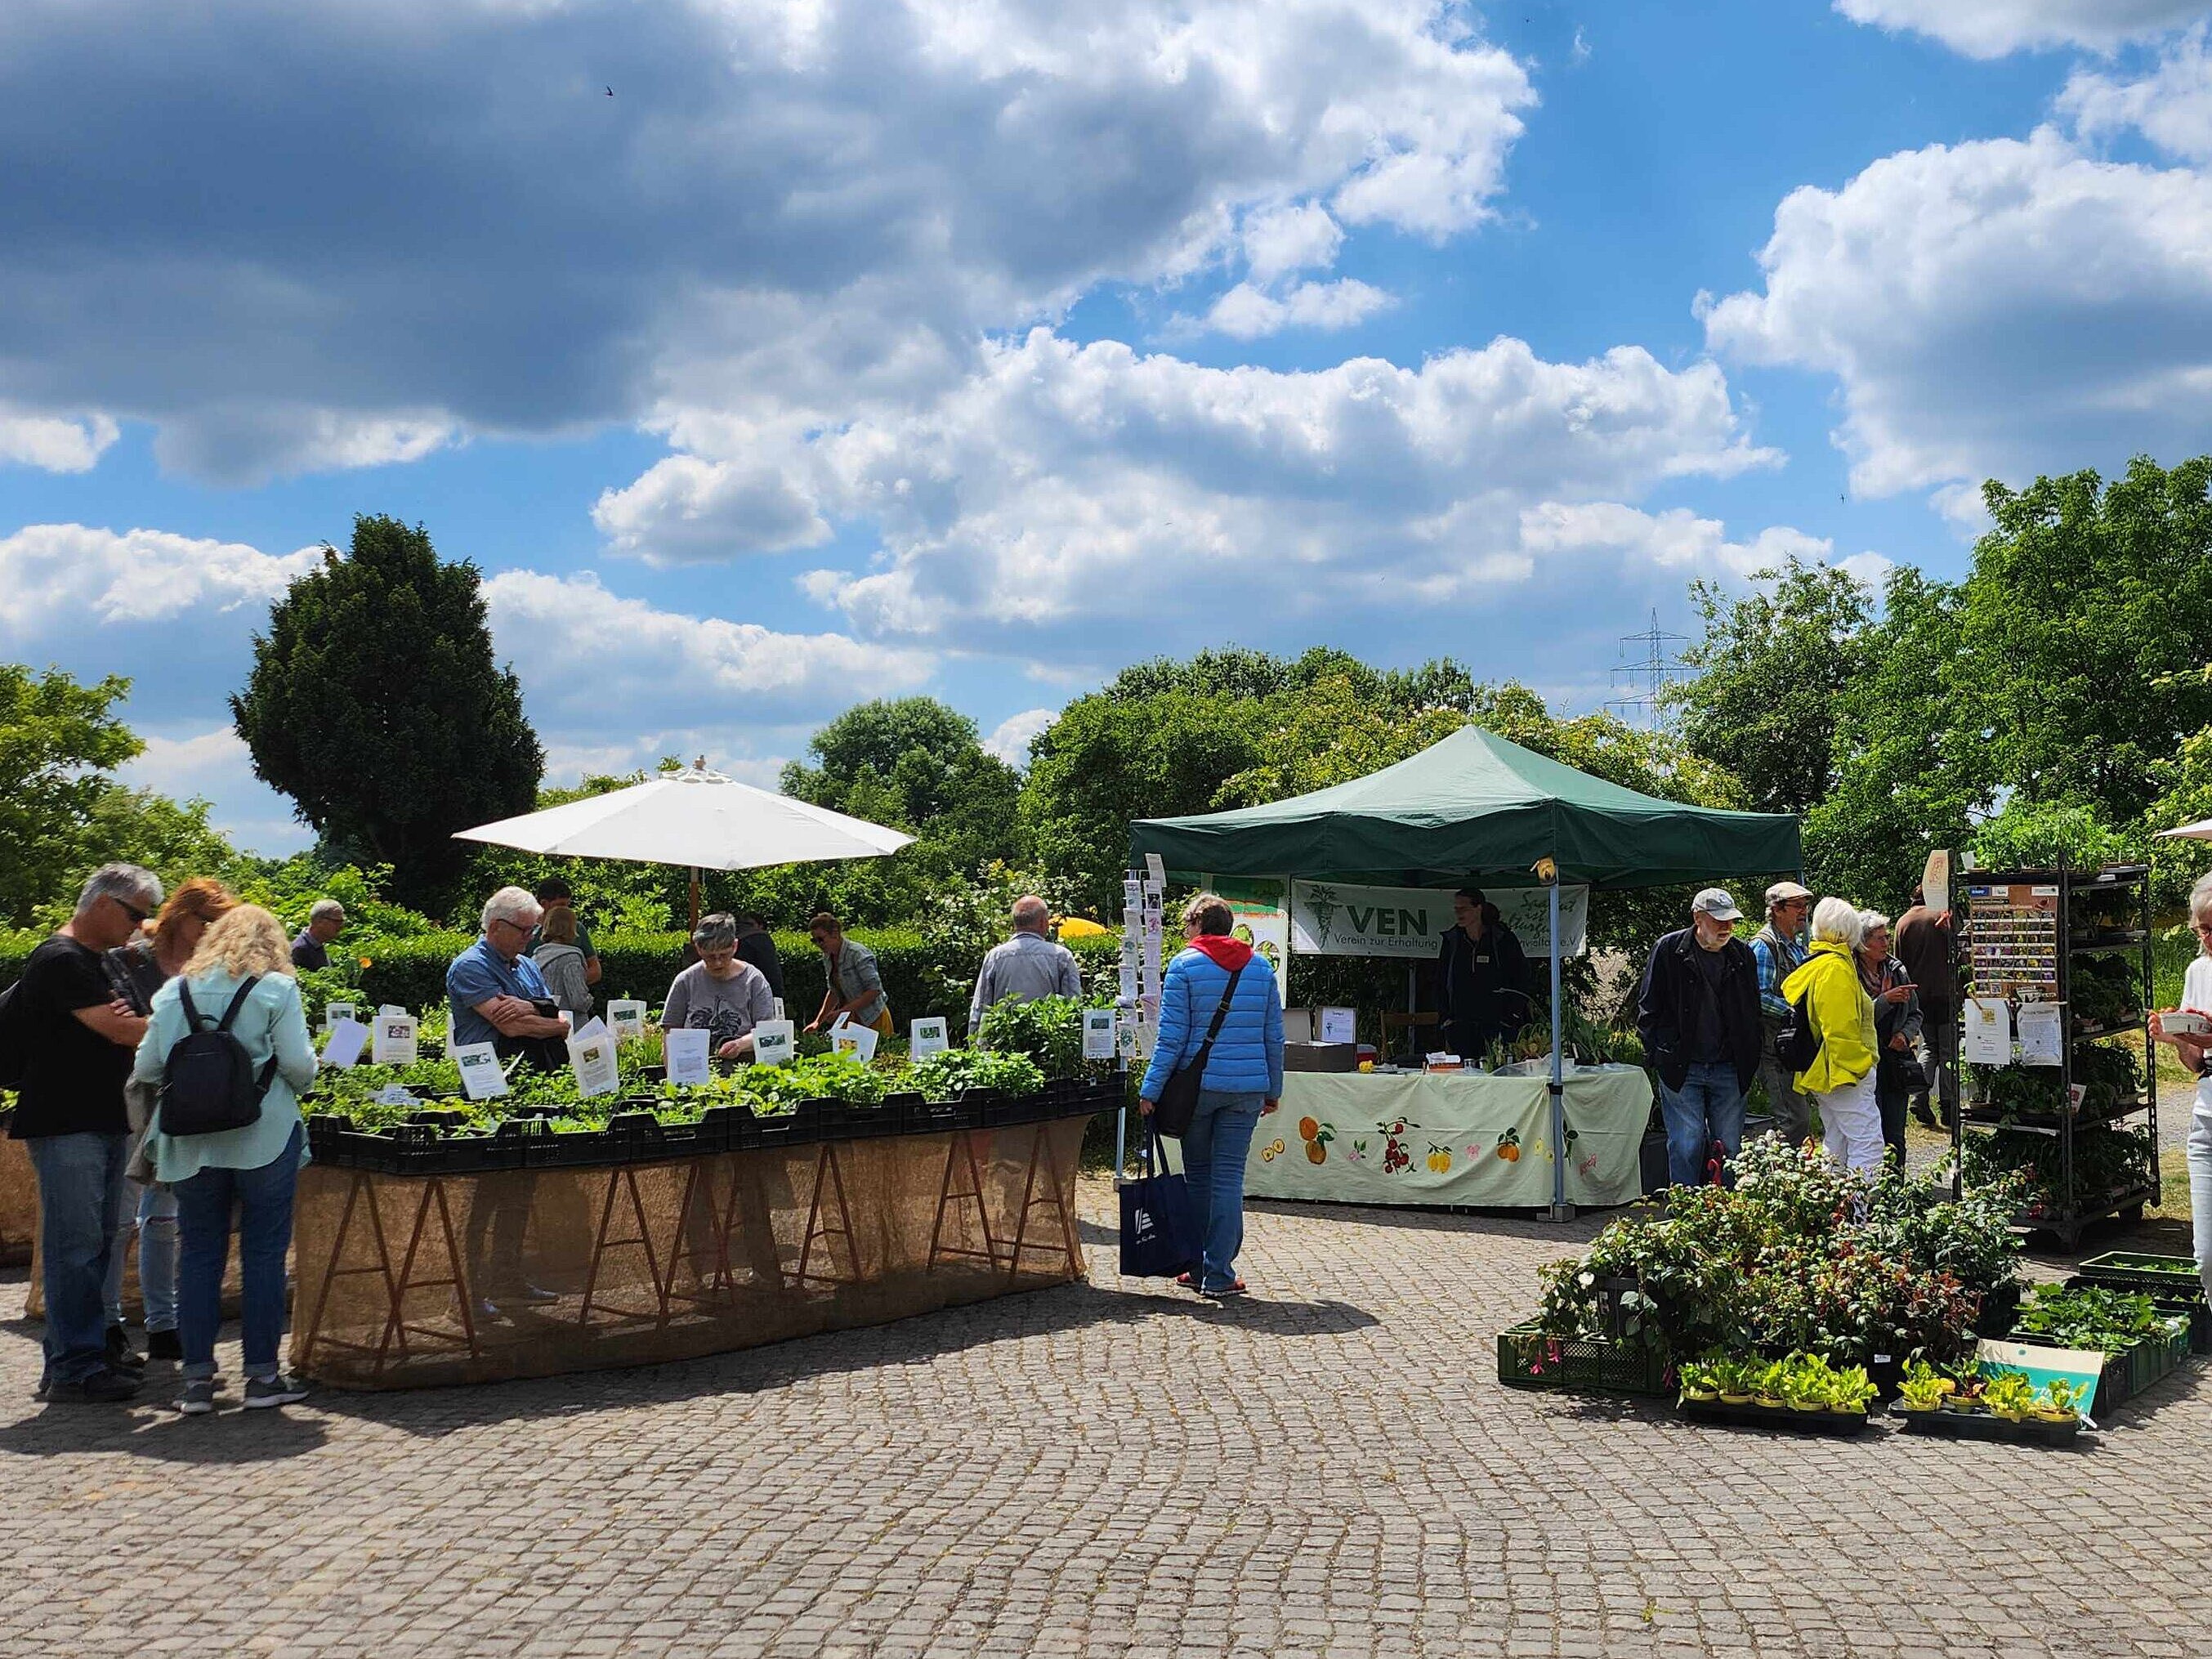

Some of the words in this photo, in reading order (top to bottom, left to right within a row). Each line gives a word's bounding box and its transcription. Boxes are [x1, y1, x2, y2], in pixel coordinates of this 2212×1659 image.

[1347, 905, 1428, 936] VEN
[1334, 932, 1366, 944] Verein
[1388, 937, 1438, 950] Erhaltung
